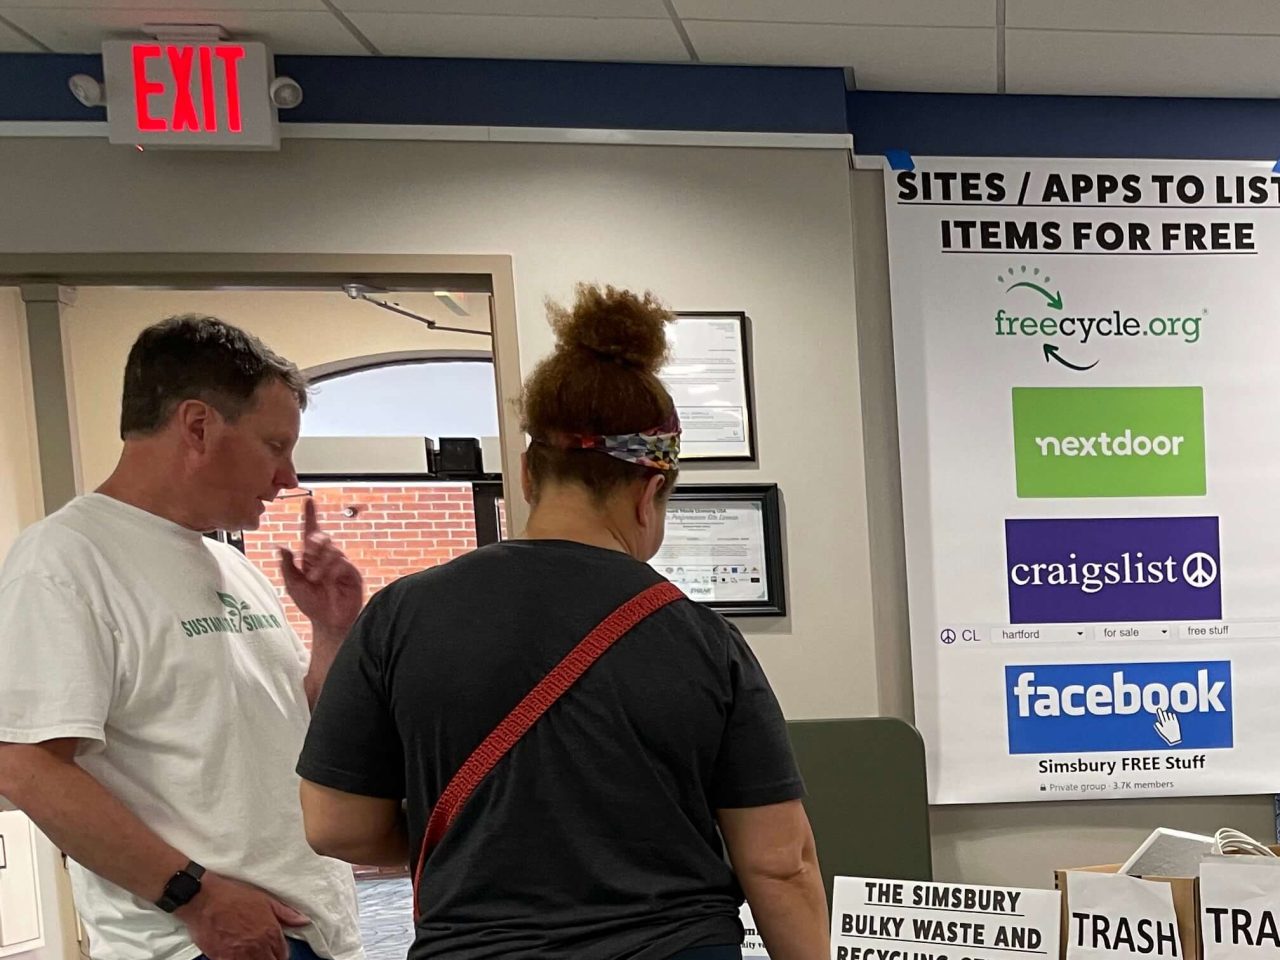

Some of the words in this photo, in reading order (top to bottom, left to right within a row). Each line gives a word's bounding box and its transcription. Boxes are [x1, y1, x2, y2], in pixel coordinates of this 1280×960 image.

[132, 44, 246, 133] EXIT
[898, 171, 1006, 201] SITES
[1042, 174, 1141, 204] APPS
[1152, 175, 1204, 204] TO
[941, 220, 1062, 249] ITEMS
[1073, 222, 1151, 251] FOR
[1162, 223, 1255, 250] FREE
[995, 310, 1201, 343] freecycle.org
[1035, 429, 1184, 456] nextdoor
[1011, 552, 1178, 593] craigslist
[962, 628, 981, 642] CL
[1002, 628, 1040, 640] hartford
[1104, 627, 1116, 638] for
[1119, 626, 1139, 637] sale
[1187, 625, 1206, 637] free
[1209, 624, 1229, 635] stuff
[1014, 669, 1226, 717] facebook
[1038, 757, 1116, 776] Simsbury
[1121, 756, 1161, 771] FREE
[1165, 754, 1206, 770] Stuff
[1049, 782, 1077, 792] Private
[1079, 784, 1106, 793] group
[1113, 780, 1131, 790] 3.7K
[1133, 779, 1174, 790] members
[865, 882, 903, 904] THE
[913, 885, 1021, 912] SIMSBURY
[842, 913, 904, 937] BULKY
[913, 919, 985, 945] WASTE
[994, 927, 1042, 949] AND
[1073, 912, 1178, 957] TRASH
